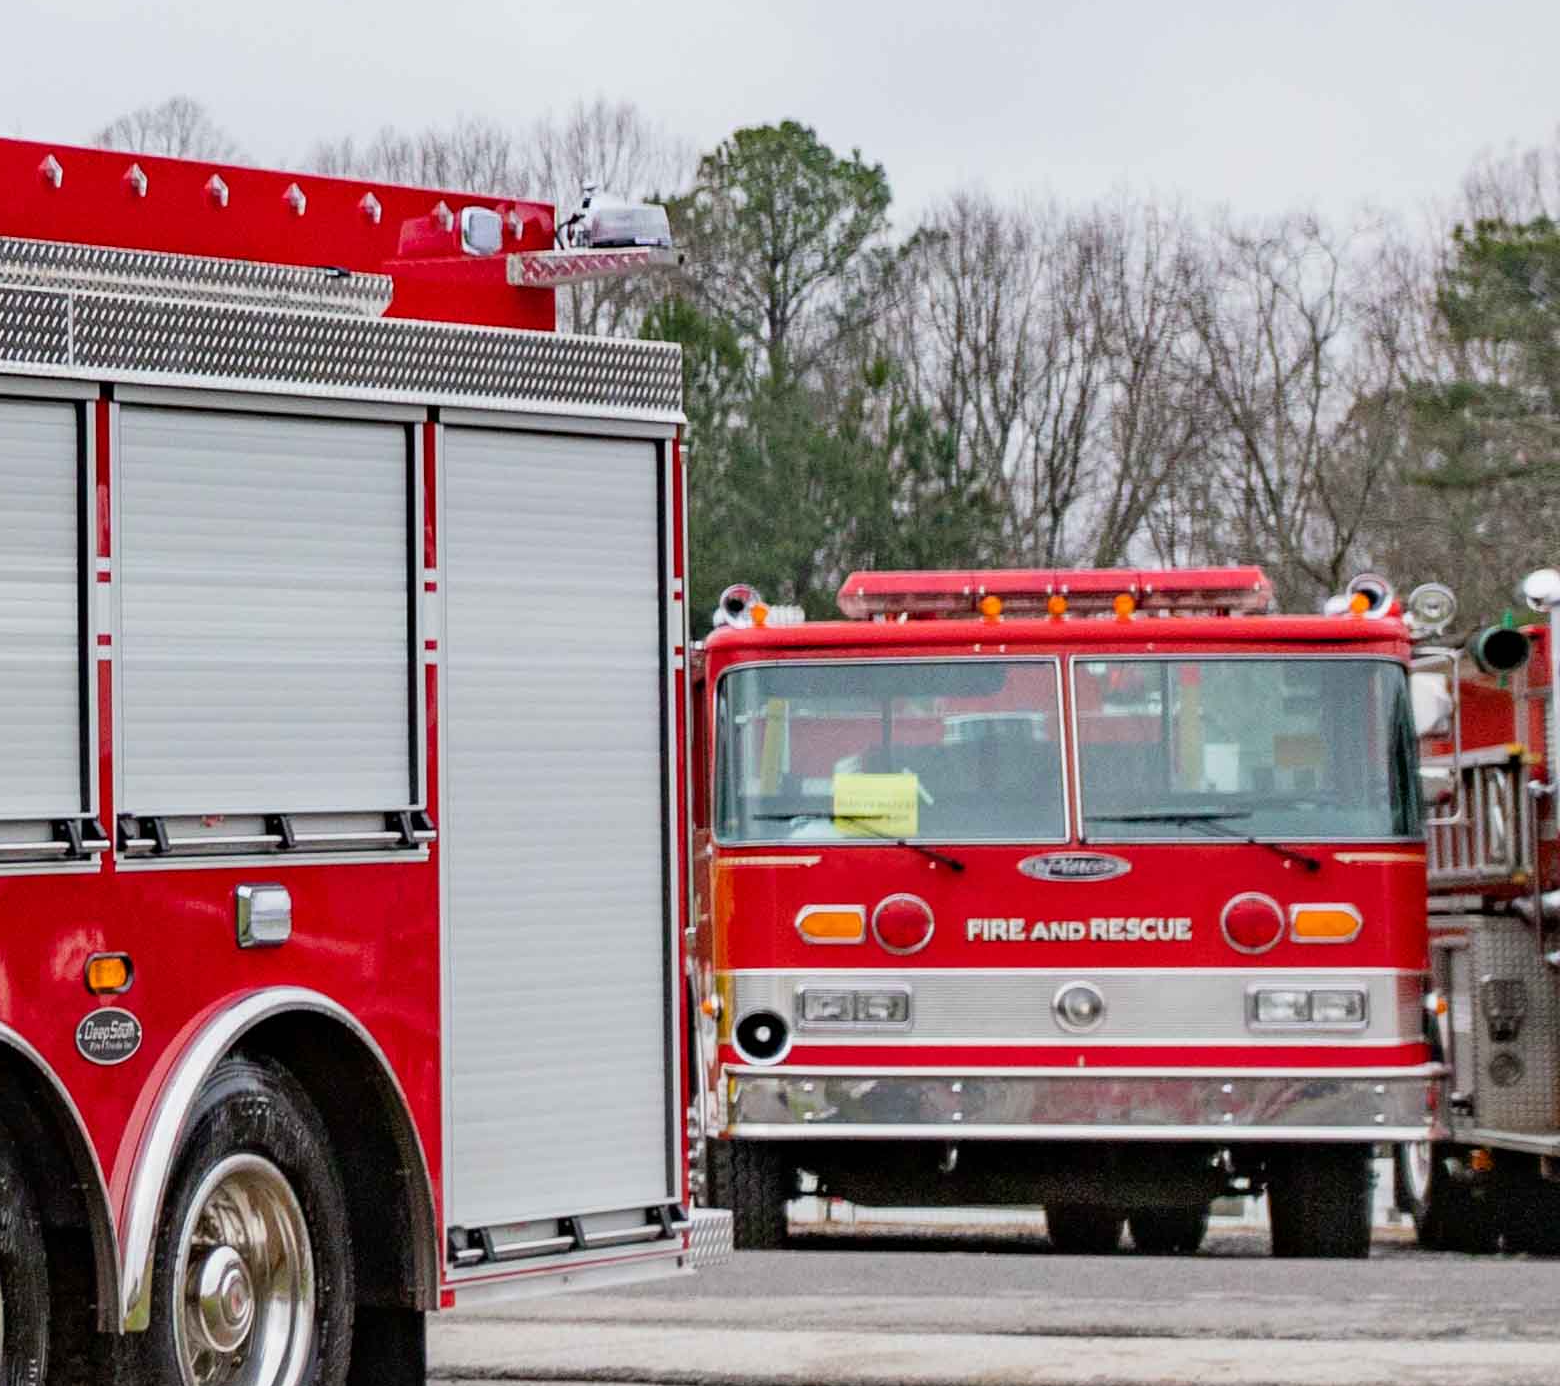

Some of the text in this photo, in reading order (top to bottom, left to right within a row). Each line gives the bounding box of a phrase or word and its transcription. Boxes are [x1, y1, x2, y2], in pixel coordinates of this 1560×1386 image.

[966, 917, 1193, 942] FIRE AND RESCUE
